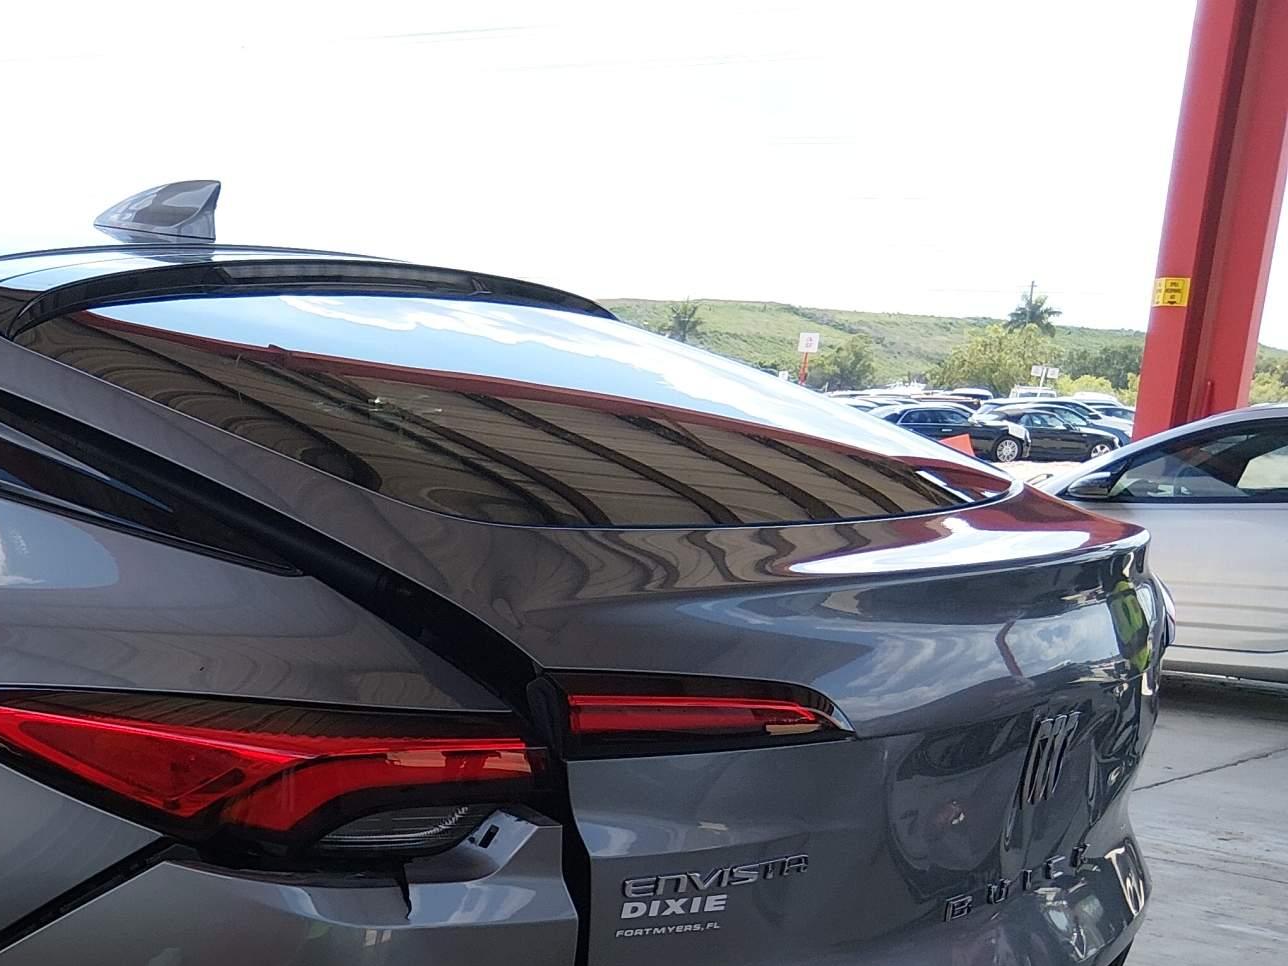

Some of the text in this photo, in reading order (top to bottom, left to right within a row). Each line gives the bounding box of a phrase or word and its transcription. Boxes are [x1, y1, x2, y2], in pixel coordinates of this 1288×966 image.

[622, 854, 809, 898] ENVISTA
[944, 843, 1092, 922] BUICK
[620, 894, 728, 919] DIXIE
